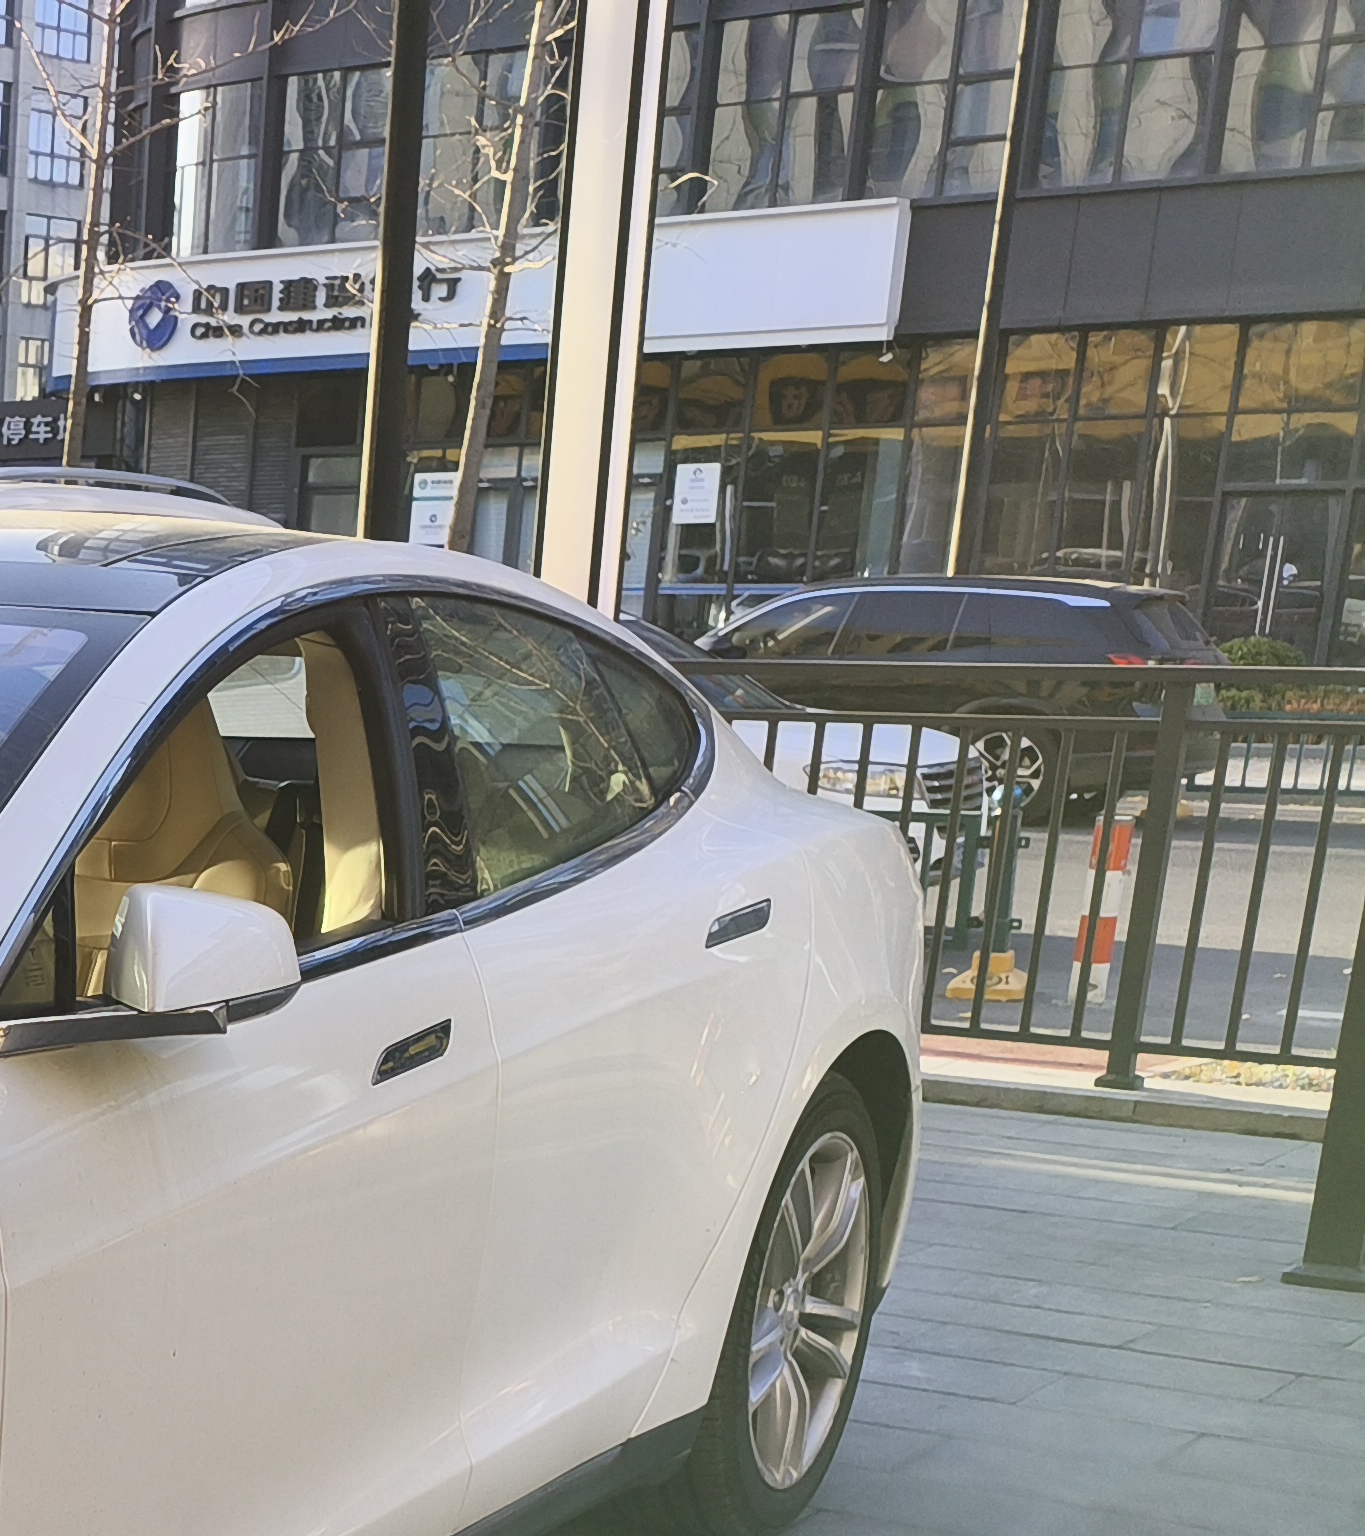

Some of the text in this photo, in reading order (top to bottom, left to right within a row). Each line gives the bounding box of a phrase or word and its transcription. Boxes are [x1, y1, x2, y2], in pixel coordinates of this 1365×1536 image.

[191, 266, 462, 317] 中国建设行
[248, 312, 367, 338] Construction
